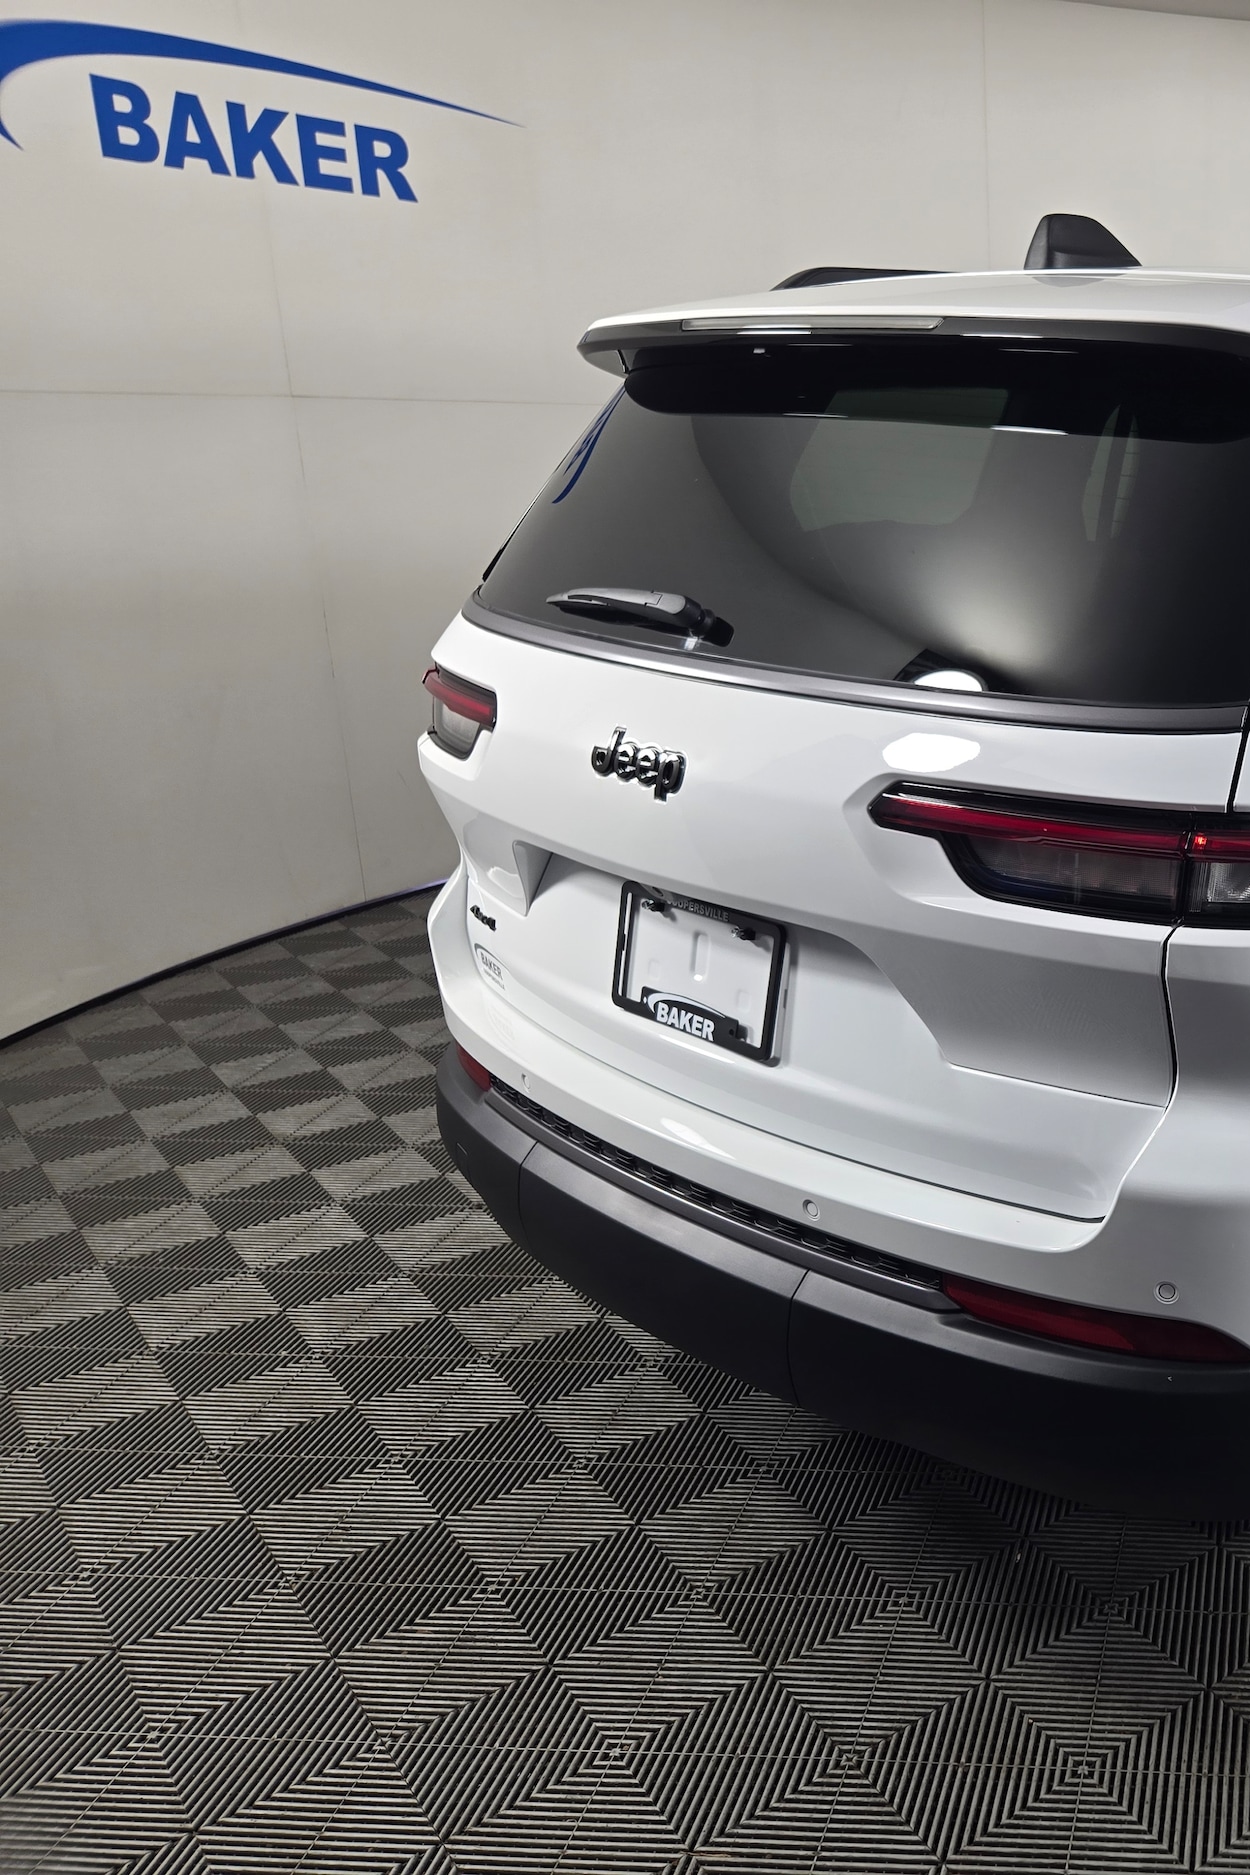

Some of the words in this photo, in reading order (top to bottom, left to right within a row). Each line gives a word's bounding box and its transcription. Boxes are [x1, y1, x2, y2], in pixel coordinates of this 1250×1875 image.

[89, 73, 418, 203] BAKER
[591, 726, 686, 802] Jeep
[656, 1001, 715, 1042] BAKER
